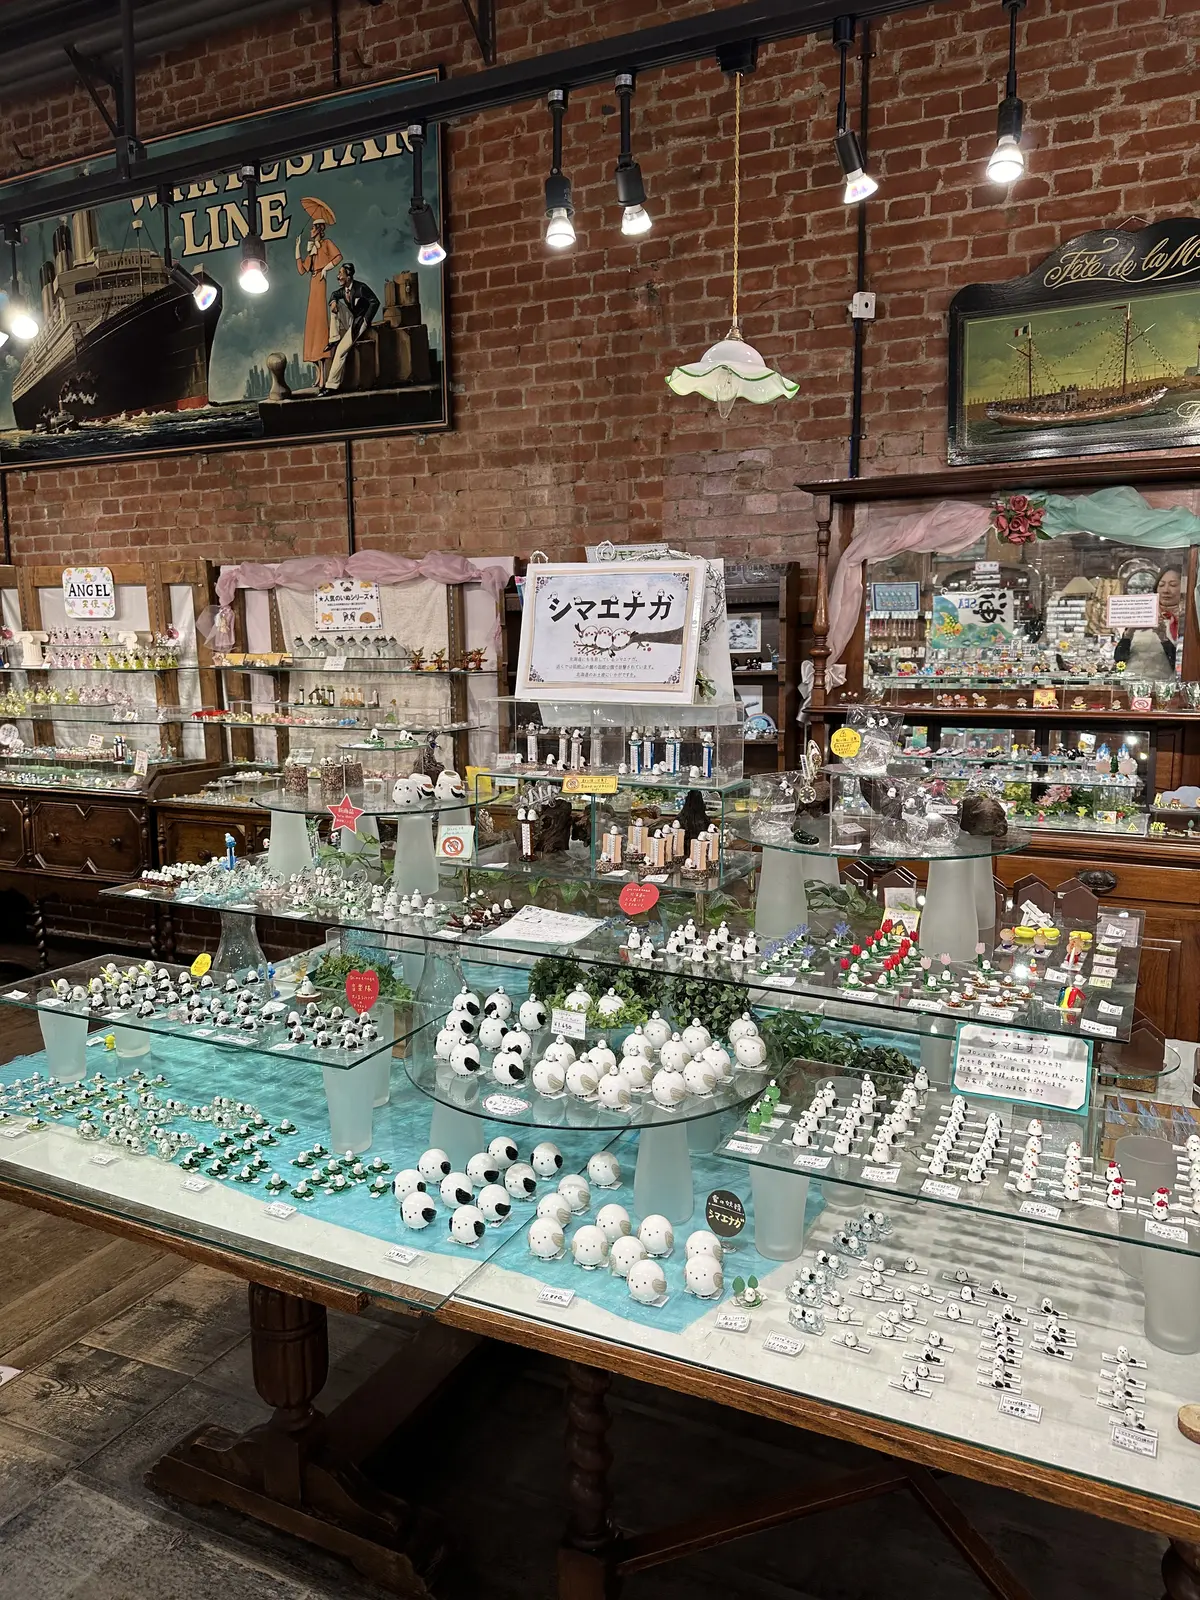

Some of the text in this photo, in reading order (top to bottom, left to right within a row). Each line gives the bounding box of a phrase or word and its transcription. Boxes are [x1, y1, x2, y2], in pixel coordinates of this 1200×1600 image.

[180, 191, 293, 257] LINE
[1107, 246, 1137, 278] de
[68, 582, 111, 597] ANGEL
[548, 594, 675, 623] シマエナガ
[988, 1038, 1051, 1056] シマエナガ
[712, 1194, 742, 1212] 雪の妖精
[708, 1208, 745, 1229] シマエナガ
